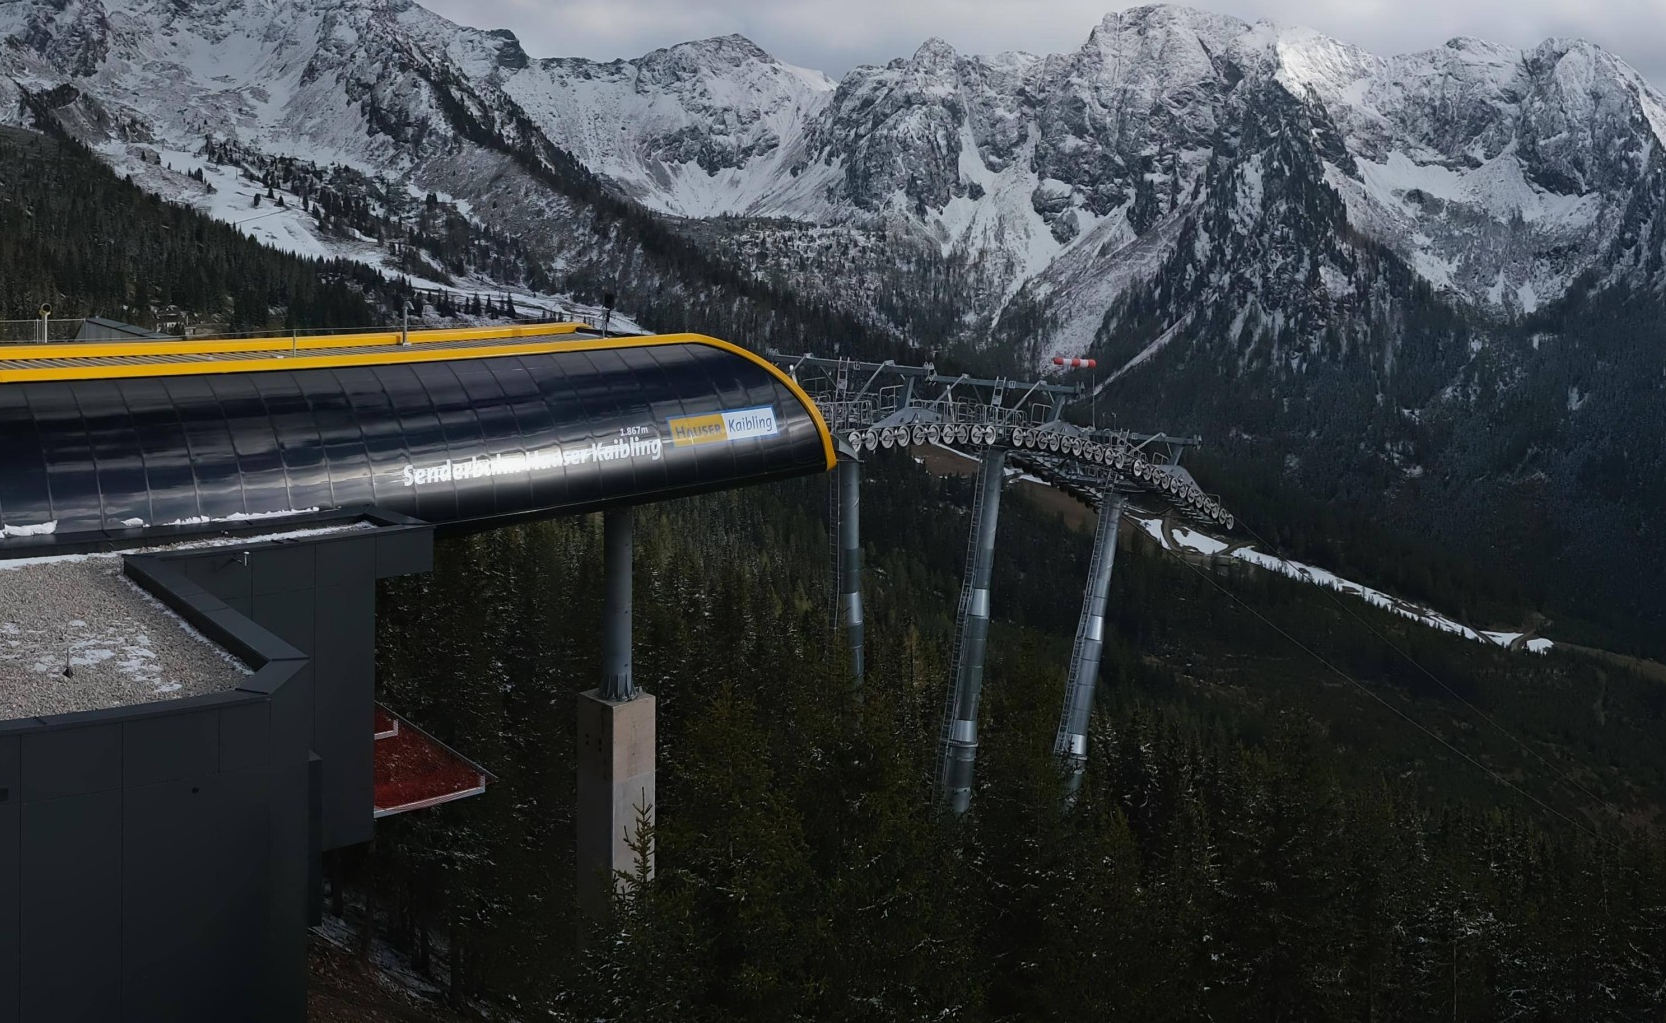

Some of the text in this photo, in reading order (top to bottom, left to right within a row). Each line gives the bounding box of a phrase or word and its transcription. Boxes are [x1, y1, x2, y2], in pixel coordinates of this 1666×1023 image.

[619, 425, 649, 438] 1.867m
[674, 415, 774, 439] HAUSER Kaibling
[591, 437, 662, 461] Kaibling
